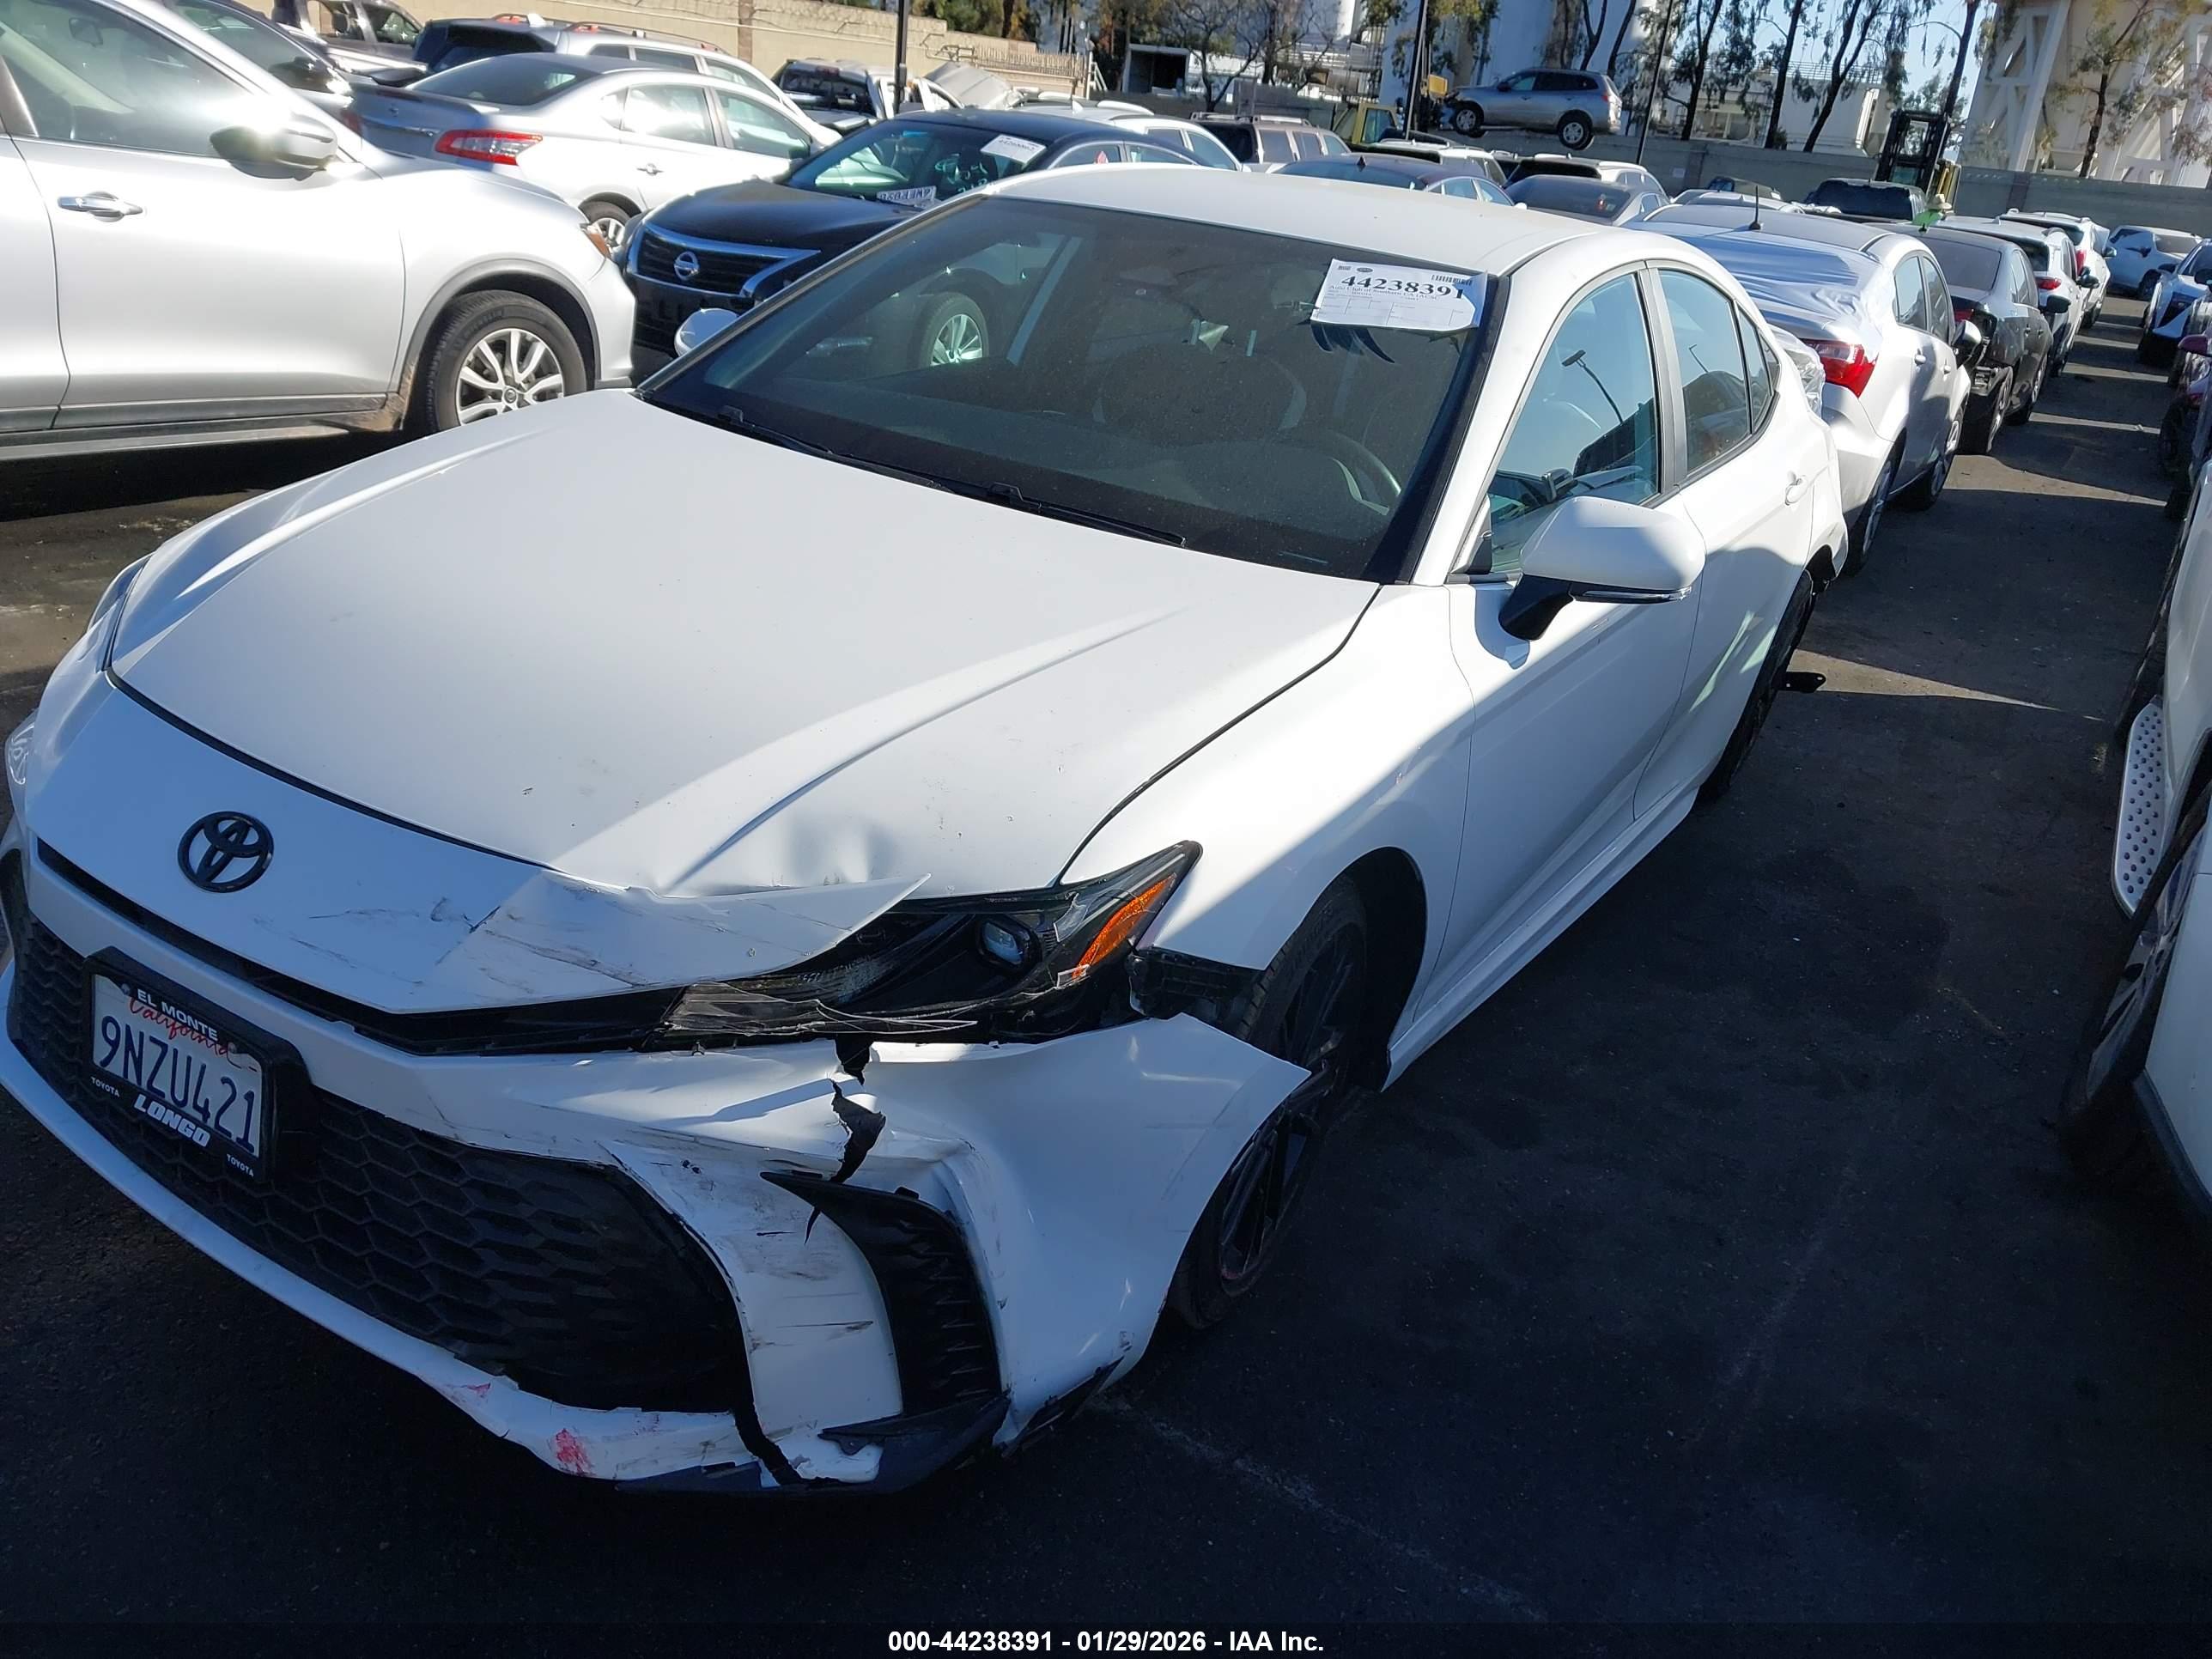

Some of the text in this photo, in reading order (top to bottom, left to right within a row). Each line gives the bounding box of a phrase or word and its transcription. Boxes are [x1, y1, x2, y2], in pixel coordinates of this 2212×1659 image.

[1341, 276, 1463, 299] 44238391
[137, 988, 219, 1042] EL MONTE
[90, 1076, 120, 1098] TOYOTA
[100, 1015, 255, 1154] 9NZU421
[133, 1093, 211, 1147] LONGO
[226, 1153, 255, 1177] TOYOTA
